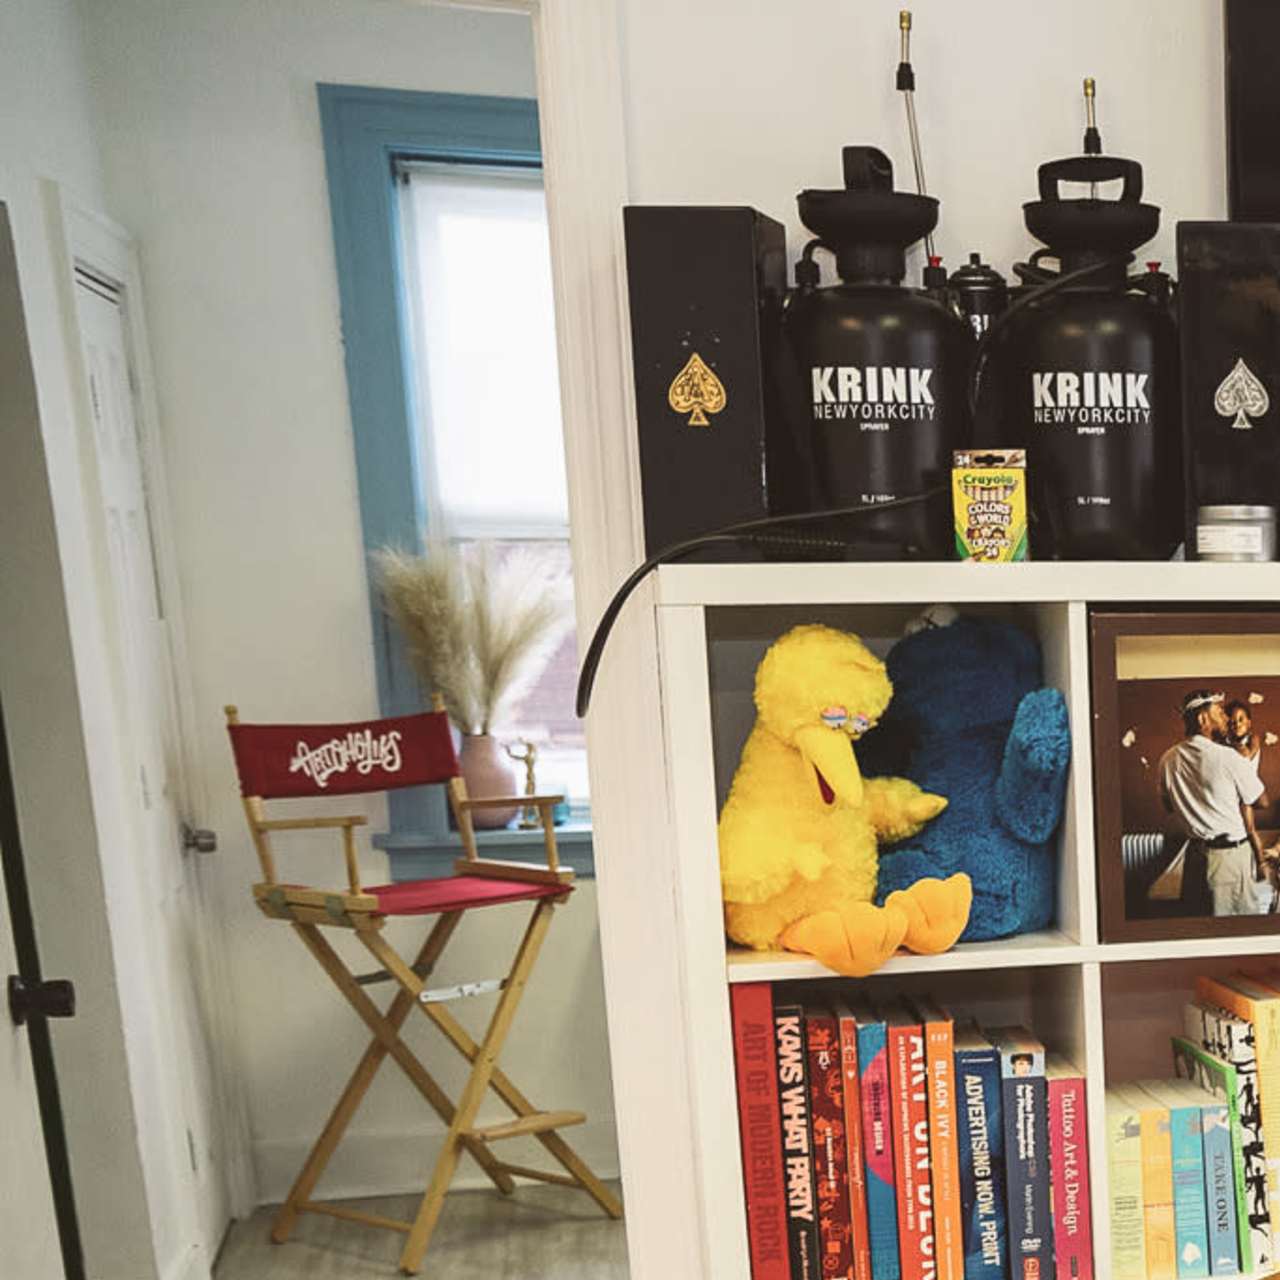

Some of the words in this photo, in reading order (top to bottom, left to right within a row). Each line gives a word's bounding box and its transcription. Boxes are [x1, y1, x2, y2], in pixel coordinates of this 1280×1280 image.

[811, 366, 935, 405] KRINK
[1032, 372, 1150, 409] KRINK
[963, 474, 1014, 486] Crayola
[968, 501, 1012, 515] COLORS
[977, 513, 1011, 526] WORLD
[743, 1021, 768, 1062] ART
[775, 1016, 804, 1085] KAWS
[746, 1070, 770, 1097] OF
[934, 1060, 949, 1108] BLACK
[1015, 1084, 1026, 1096] for
[1024, 1084, 1035, 1112] Adobe
[780, 1085, 810, 1155] WHAT
[936, 1114, 950, 1139] IVY
[963, 1073, 992, 1178] ADVERTISING
[1015, 1096, 1028, 1160] Photographers
[1061, 1089, 1076, 1139] Tattoo
[747, 1103, 777, 1198] MODERN
[1026, 1112, 1038, 1159] Photoshop
[1063, 1140, 1078, 1167] Art
[786, 1156, 814, 1222] PARTY
[1024, 1184, 1034, 1205] Martin
[1213, 1153, 1227, 1197] TAKE
[975, 1178, 996, 1219] NOW.
[1061, 1182, 1081, 1236] Design
[1216, 1198, 1230, 1233] ONE
[1024, 1206, 1036, 1234] Evening
[981, 1220, 1000, 1267] PRINT
